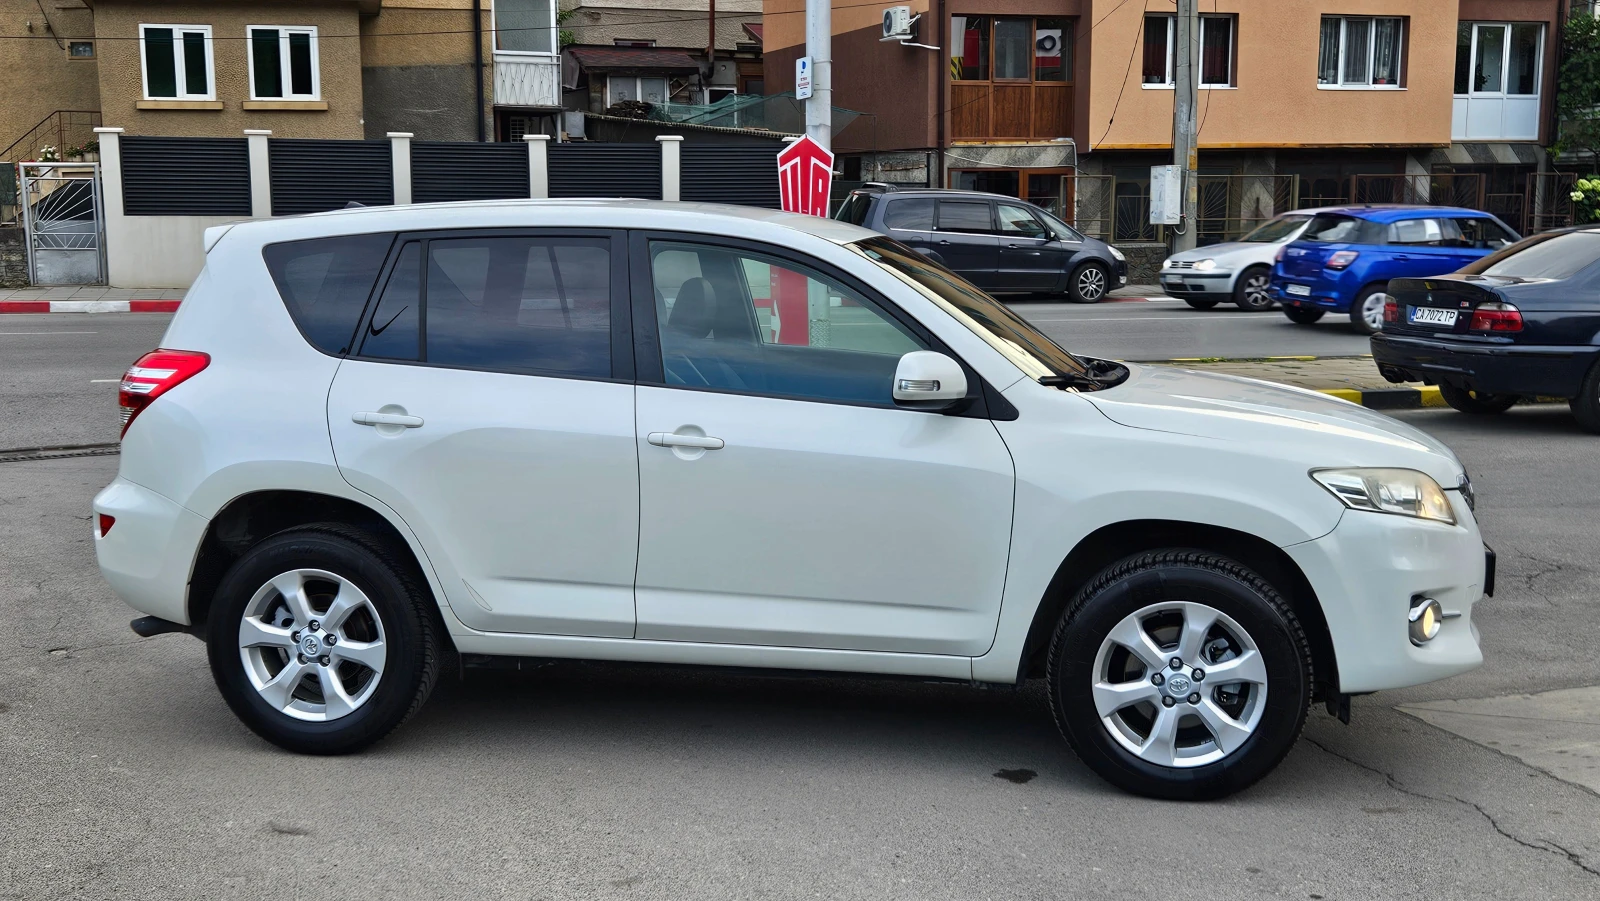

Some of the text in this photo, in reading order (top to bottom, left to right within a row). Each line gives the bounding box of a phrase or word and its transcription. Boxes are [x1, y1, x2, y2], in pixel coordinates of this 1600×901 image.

[1415, 308, 1456, 322] CA 7072 TP
